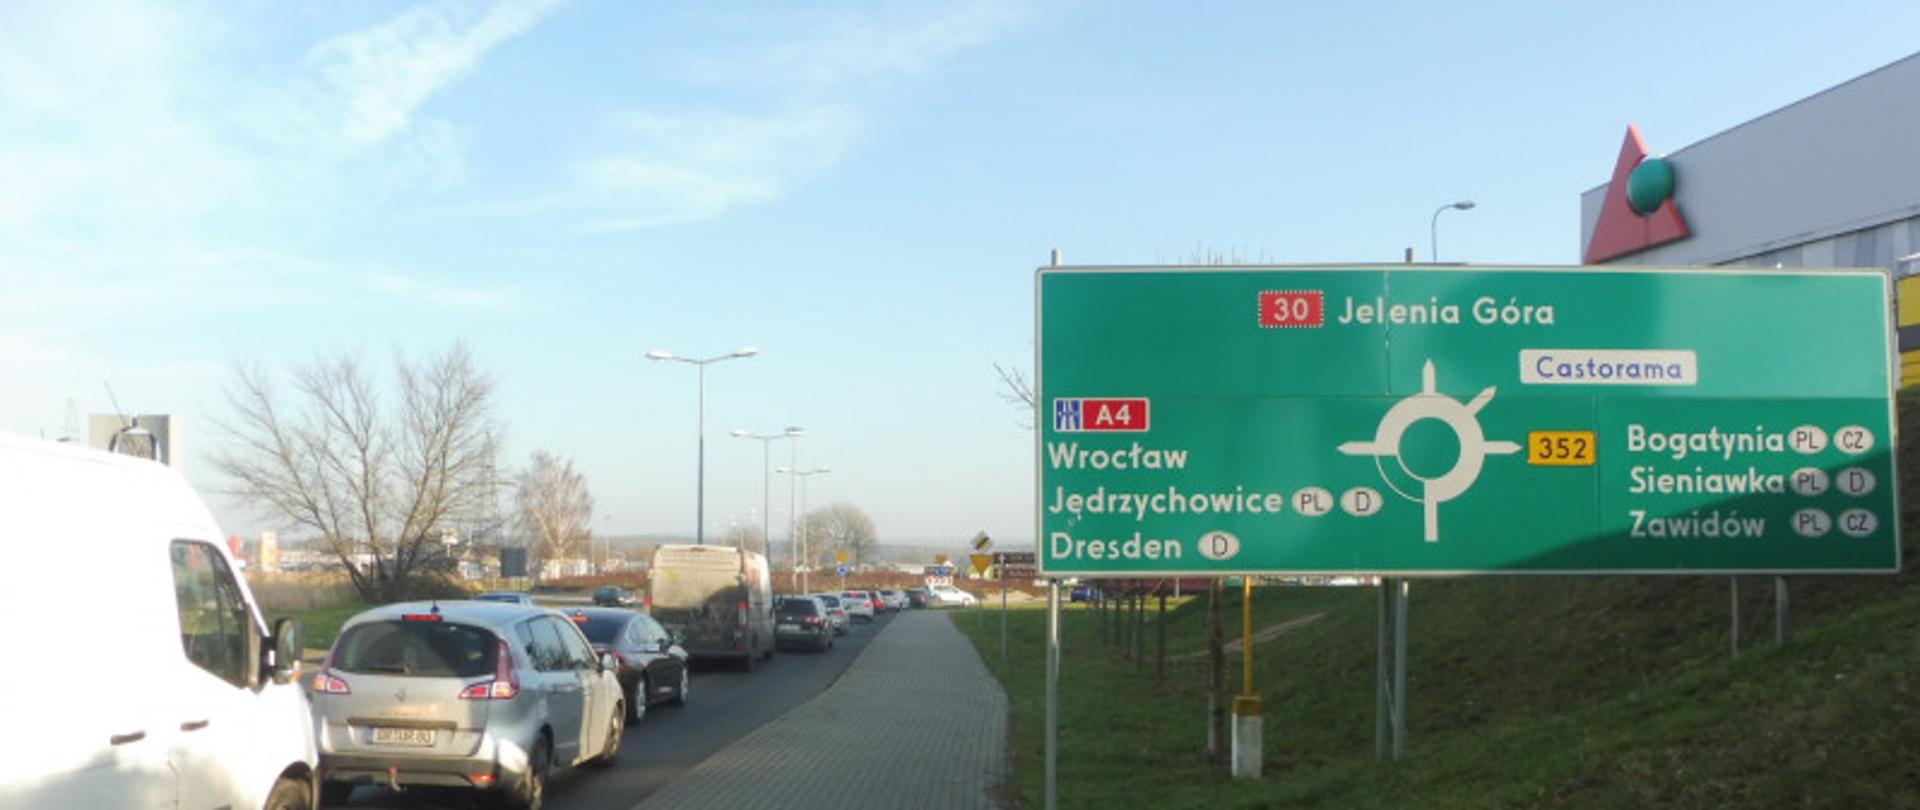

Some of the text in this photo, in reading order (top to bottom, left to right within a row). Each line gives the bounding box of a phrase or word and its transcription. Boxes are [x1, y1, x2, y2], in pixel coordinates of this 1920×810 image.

[1274, 296, 1556, 325] 30 Jelenia Góra
[1536, 356, 1683, 379] Castorama
[1095, 404, 1131, 425] A4
[1538, 438, 1587, 459] 352
[1628, 424, 1863, 459] Bogatynia PL CZ
[1048, 443, 1188, 470] Wrocław
[1628, 466, 1865, 494] Sieniawka PL D
[1049, 486, 1371, 521] Jędrzychowice PL D
[1630, 510, 1867, 538] Zawidów PL CZ
[1051, 532, 1181, 559] Dresden
[1212, 536, 1228, 556] D
